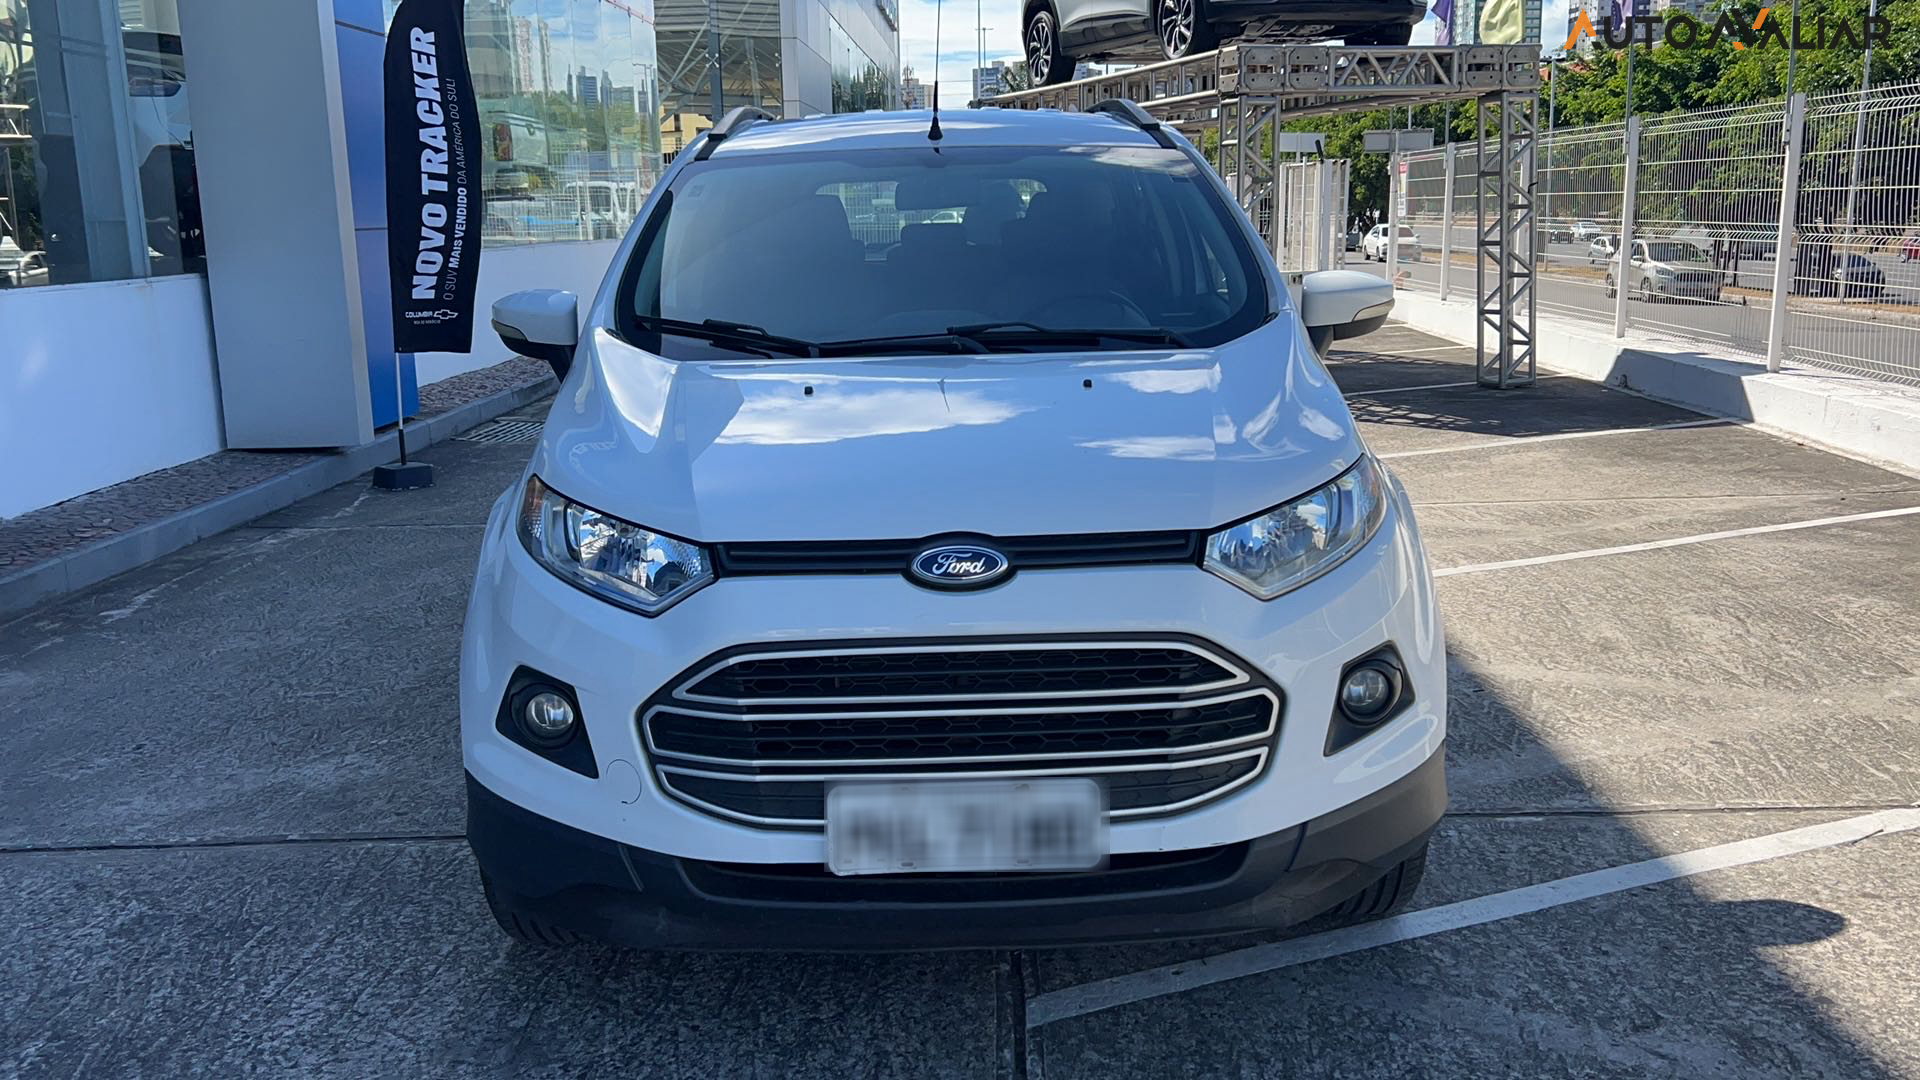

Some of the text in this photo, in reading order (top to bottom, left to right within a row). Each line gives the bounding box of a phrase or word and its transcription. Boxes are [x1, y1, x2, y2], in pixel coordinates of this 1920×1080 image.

[410, 26, 448, 196] TRACKER
[412, 202, 447, 300] NOVO
[443, 78, 467, 300] O SUV MAIS VENDIDO DA AMÉRICA DO SUL!
[932, 552, 986, 575] Ford
